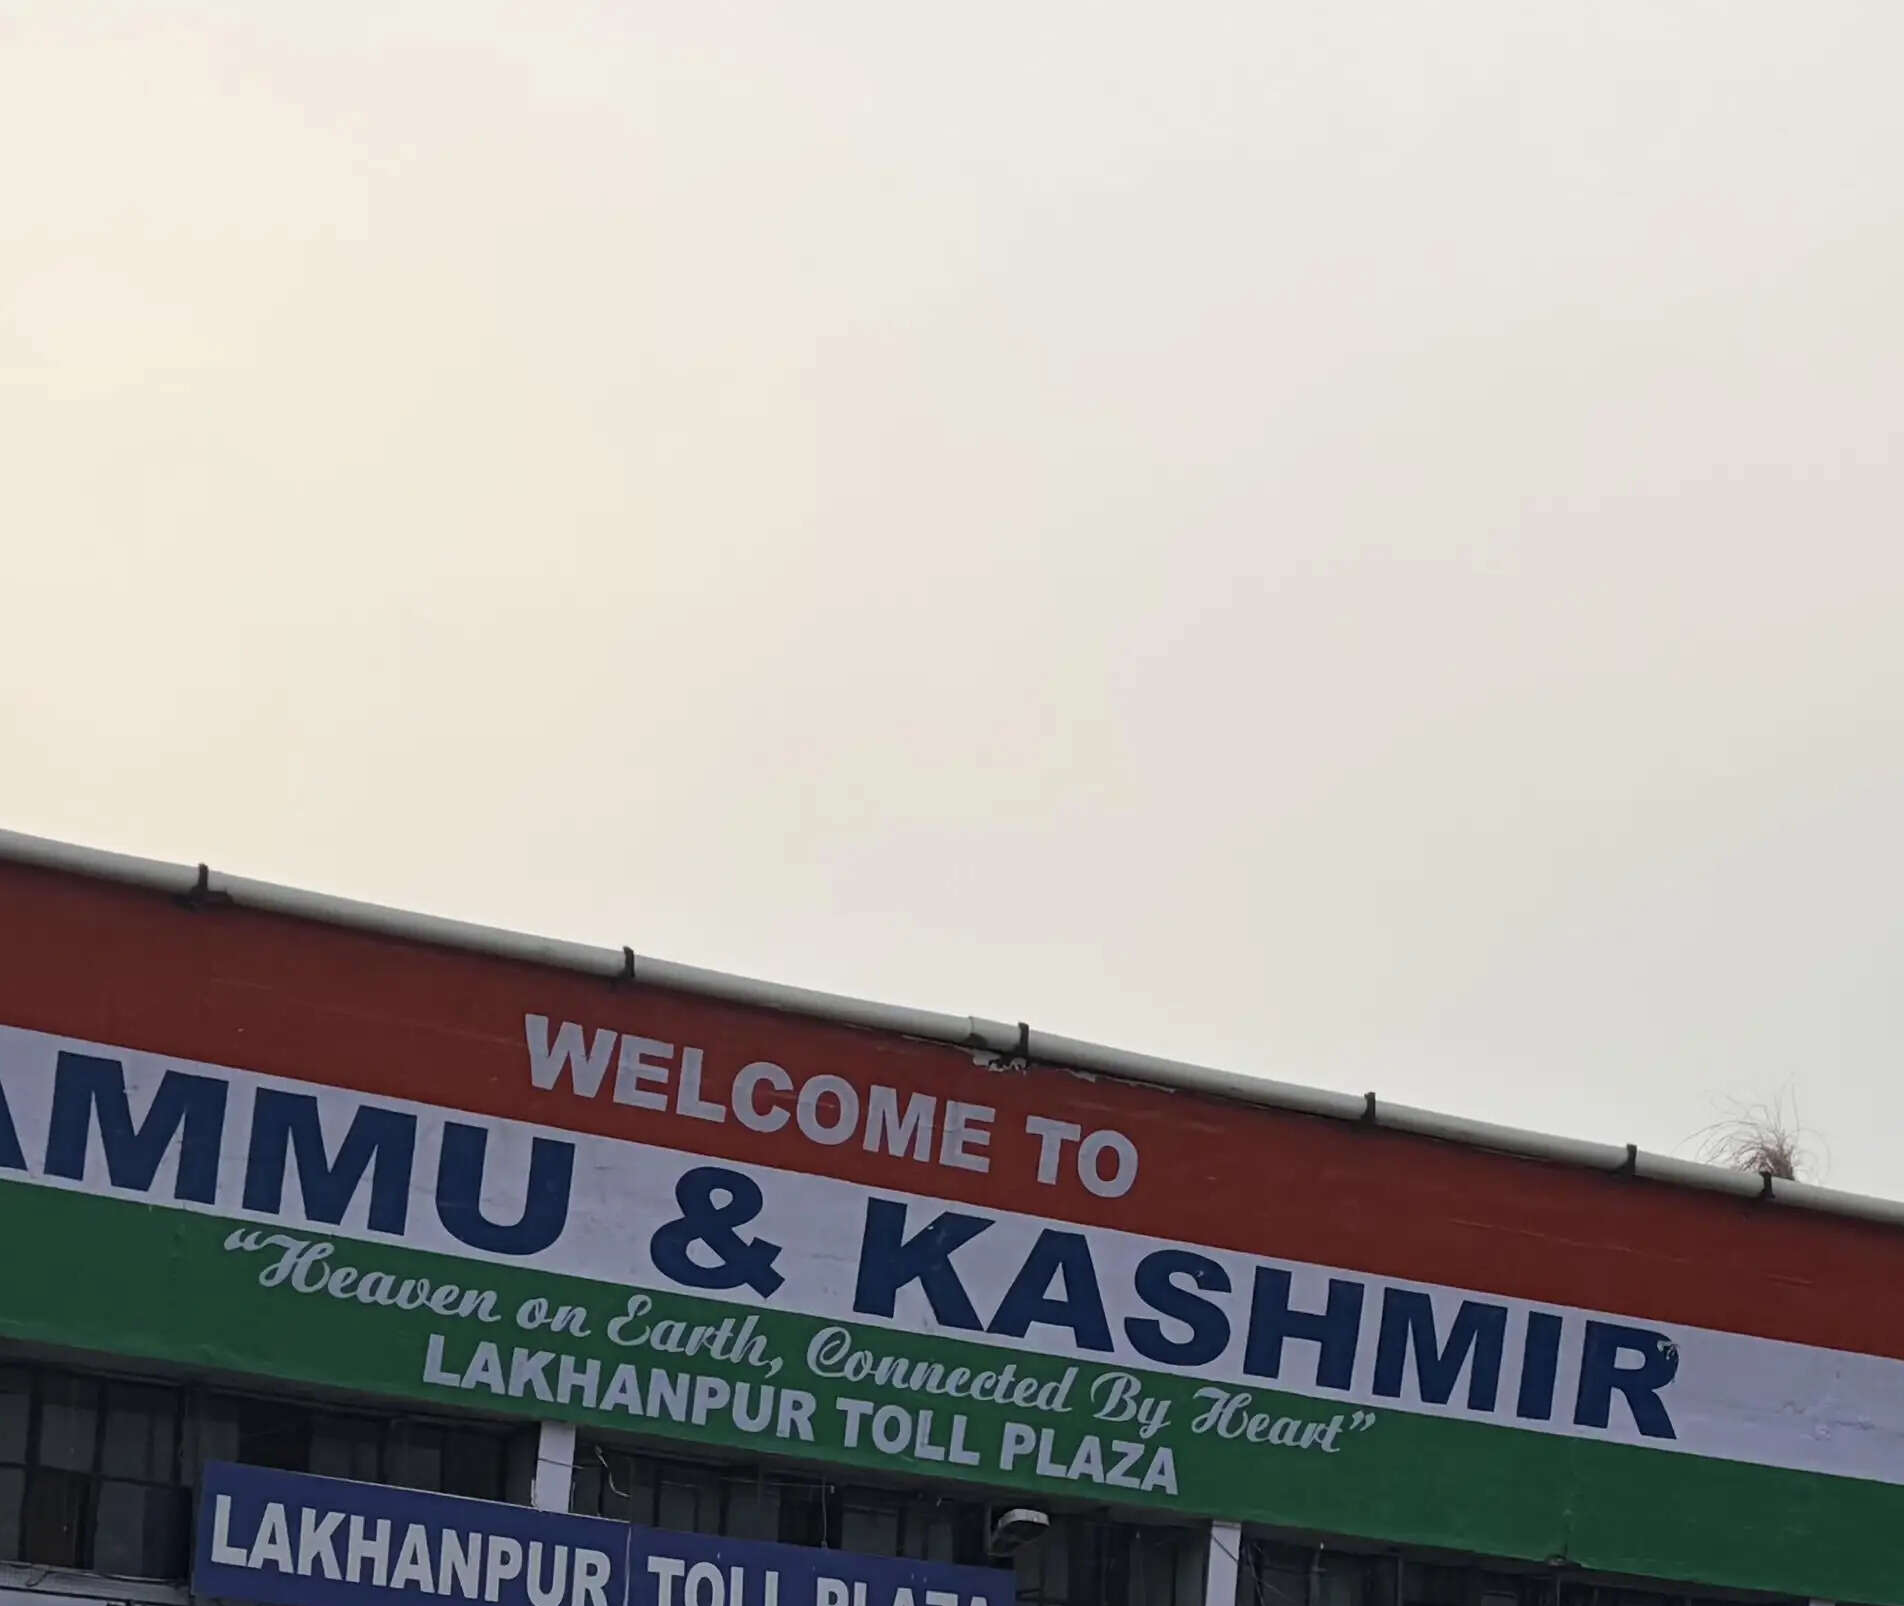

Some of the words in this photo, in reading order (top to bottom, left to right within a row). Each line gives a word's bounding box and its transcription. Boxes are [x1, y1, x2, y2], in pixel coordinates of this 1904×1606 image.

[526, 1014, 995, 1172] WELCOME
[1027, 1116, 1137, 1197] TO
[517, 1299, 590, 1336] on
[608, 1295, 783, 1377] Earth,
[808, 1327, 1078, 1411] Connected
[1091, 1373, 1171, 1438] By
[650, 1167, 785, 1299] &
[853, 1197, 1679, 1440] KASHMIR
[424, 1335, 815, 1440] LAKHANPUR
[837, 1398, 979, 1464] TOLL
[1001, 1423, 1177, 1494] PLAZA
